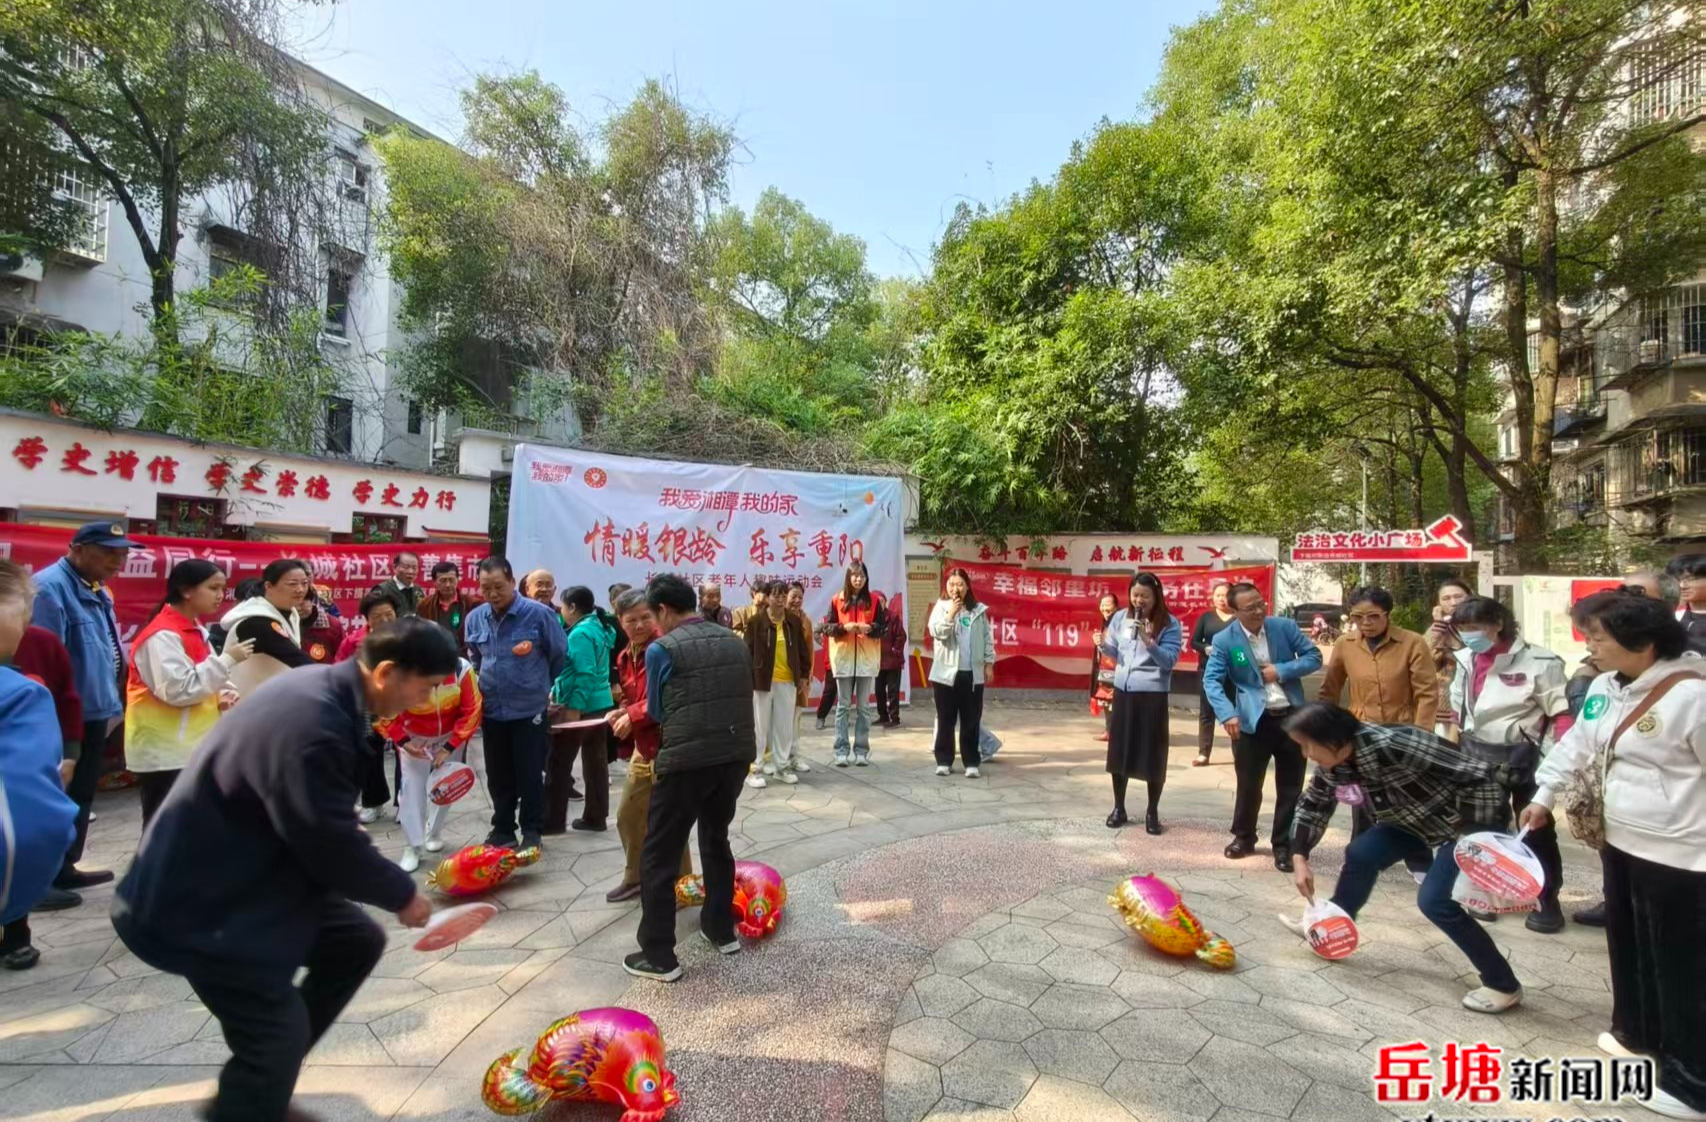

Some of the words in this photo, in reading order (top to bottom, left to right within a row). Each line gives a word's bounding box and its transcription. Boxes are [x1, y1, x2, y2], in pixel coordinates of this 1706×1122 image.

[12, 436, 179, 484] 学史增信
[204, 459, 331, 500] 学史崇德
[352, 479, 457, 511] 学史力行
[584, 516, 725, 568] 情暖银龄
[750, 527, 864, 569] 乐享重阳
[1297, 533, 1423, 548] 法治文化小广场
[1090, 545, 1184, 562] 启航新征程
[993, 571, 1109, 597] 幸福邻里坊
[1586, 700, 1602, 715] 3
